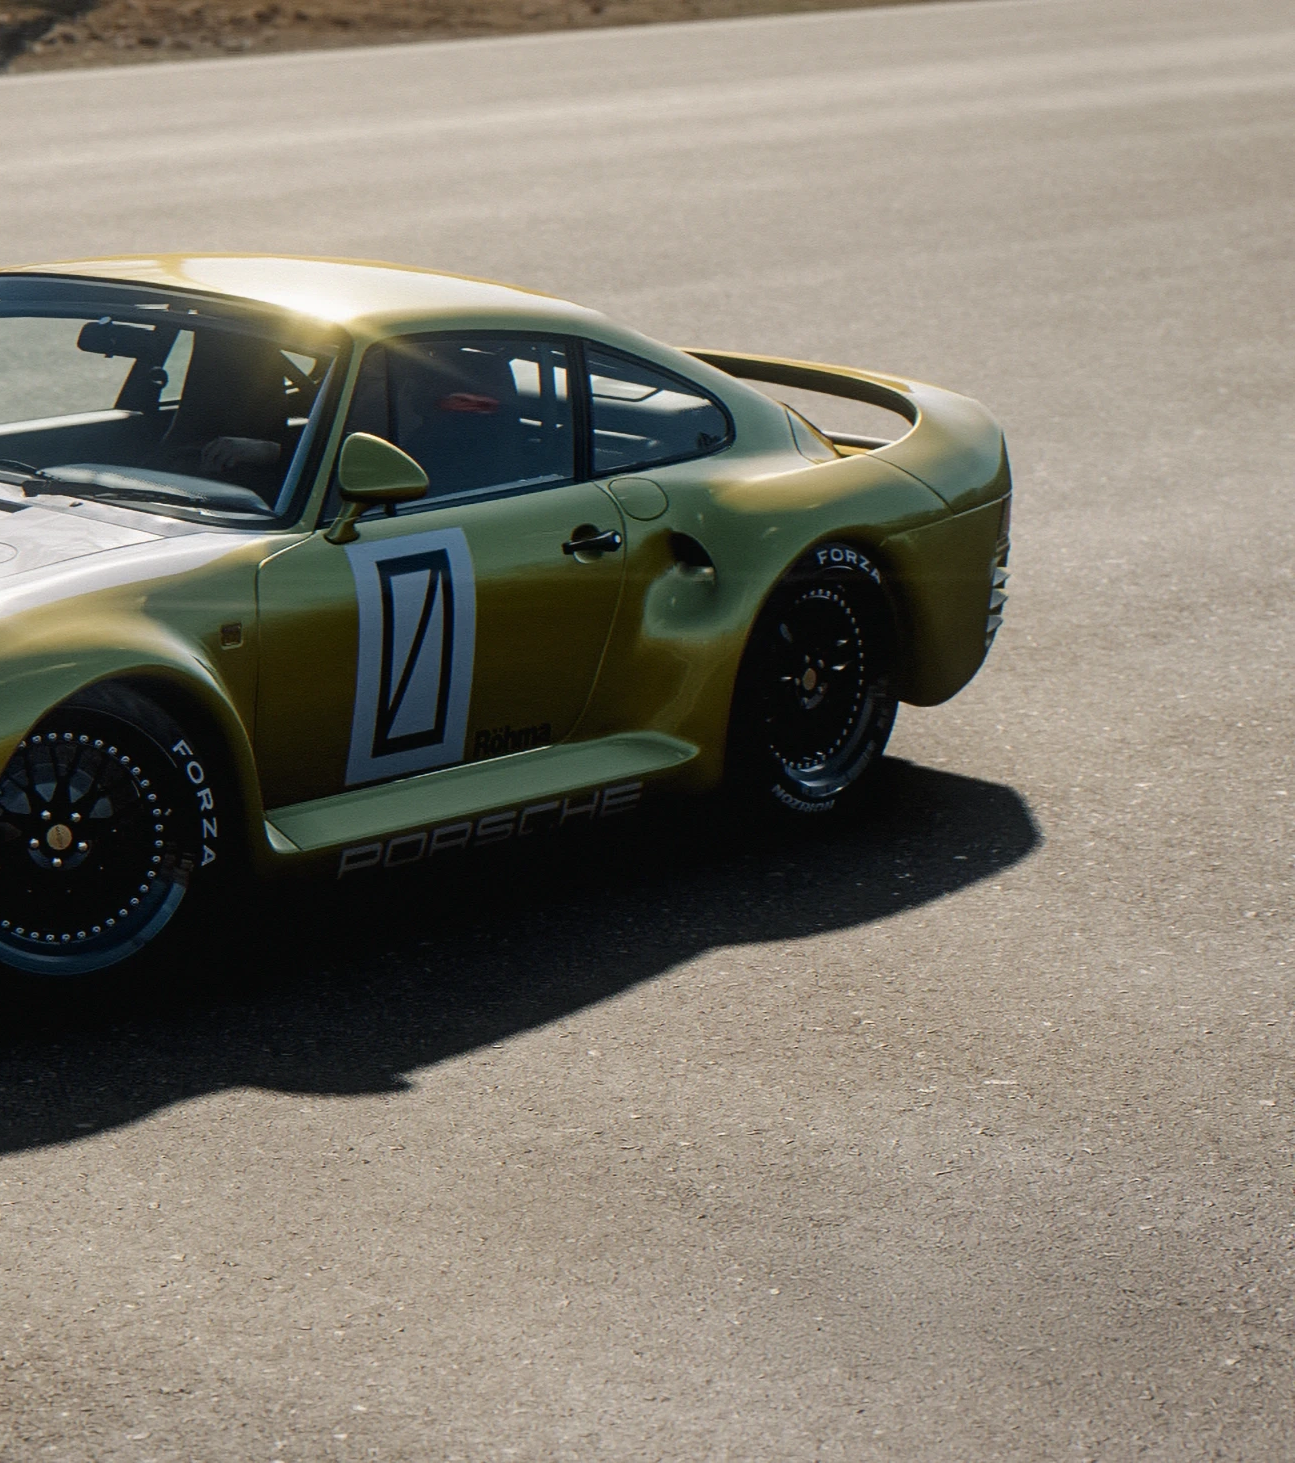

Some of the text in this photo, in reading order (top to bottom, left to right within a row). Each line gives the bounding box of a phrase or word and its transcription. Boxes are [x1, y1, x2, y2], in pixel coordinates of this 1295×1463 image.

[816, 548, 881, 585] FORZA
[473, 722, 553, 758] Röhma
[172, 740, 218, 867] FORZA
[337, 781, 644, 880] PORSCHE
